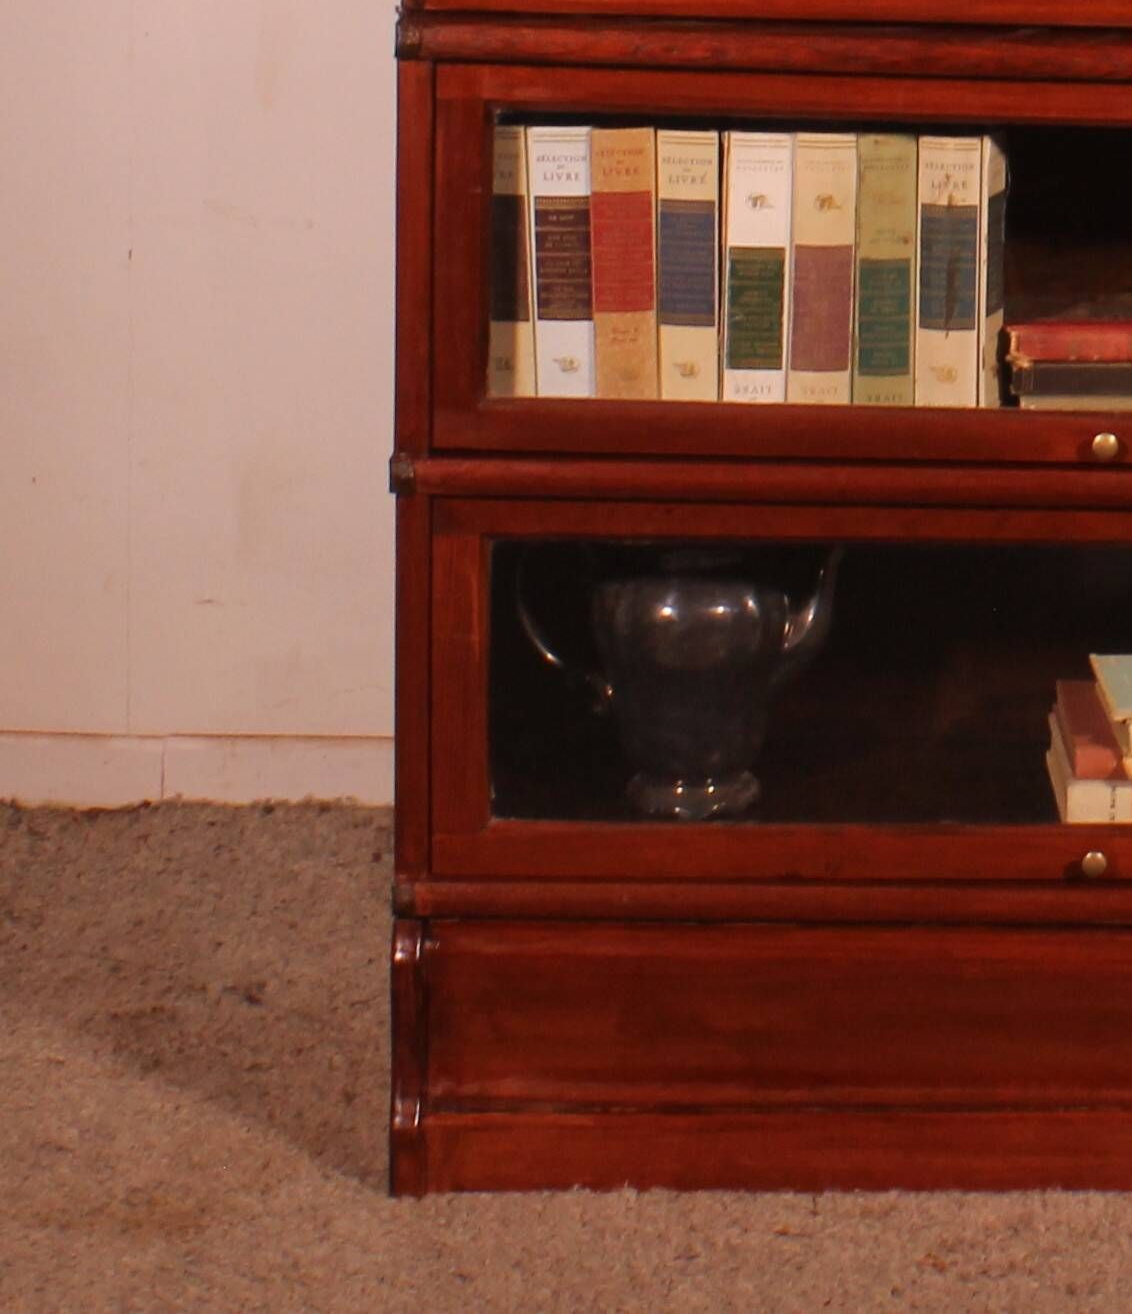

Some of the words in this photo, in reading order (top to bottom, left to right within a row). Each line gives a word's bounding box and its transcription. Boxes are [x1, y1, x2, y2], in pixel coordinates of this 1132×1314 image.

[543, 171, 580, 182] LIVRE
[602, 166, 641, 177] LIVRE
[667, 172, 709, 185] LIVRE
